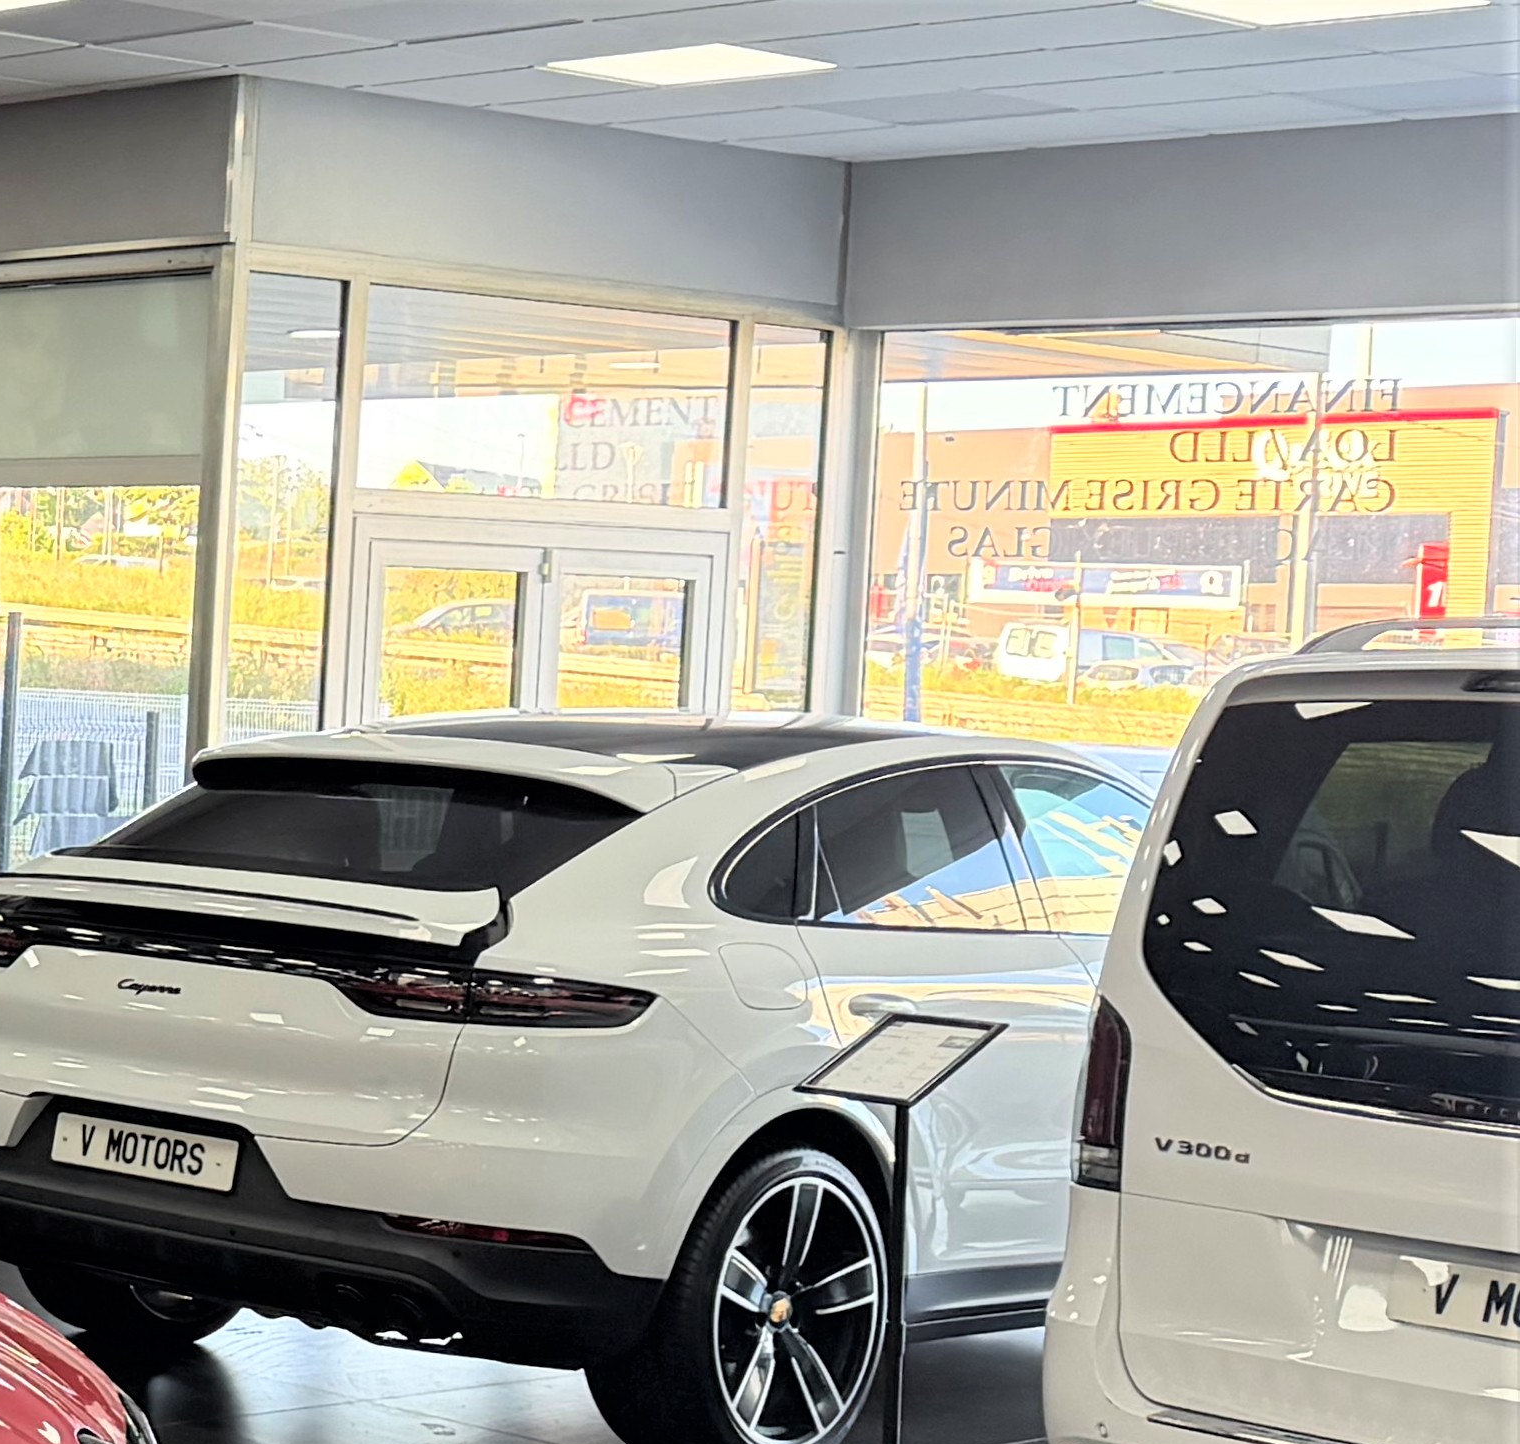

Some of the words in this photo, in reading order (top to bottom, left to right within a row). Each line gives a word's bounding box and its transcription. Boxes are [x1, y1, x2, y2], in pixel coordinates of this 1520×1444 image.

[82, 1124, 96, 1157] V
[105, 1128, 206, 1175] MOTORS
[1435, 1273, 1460, 1315] V
